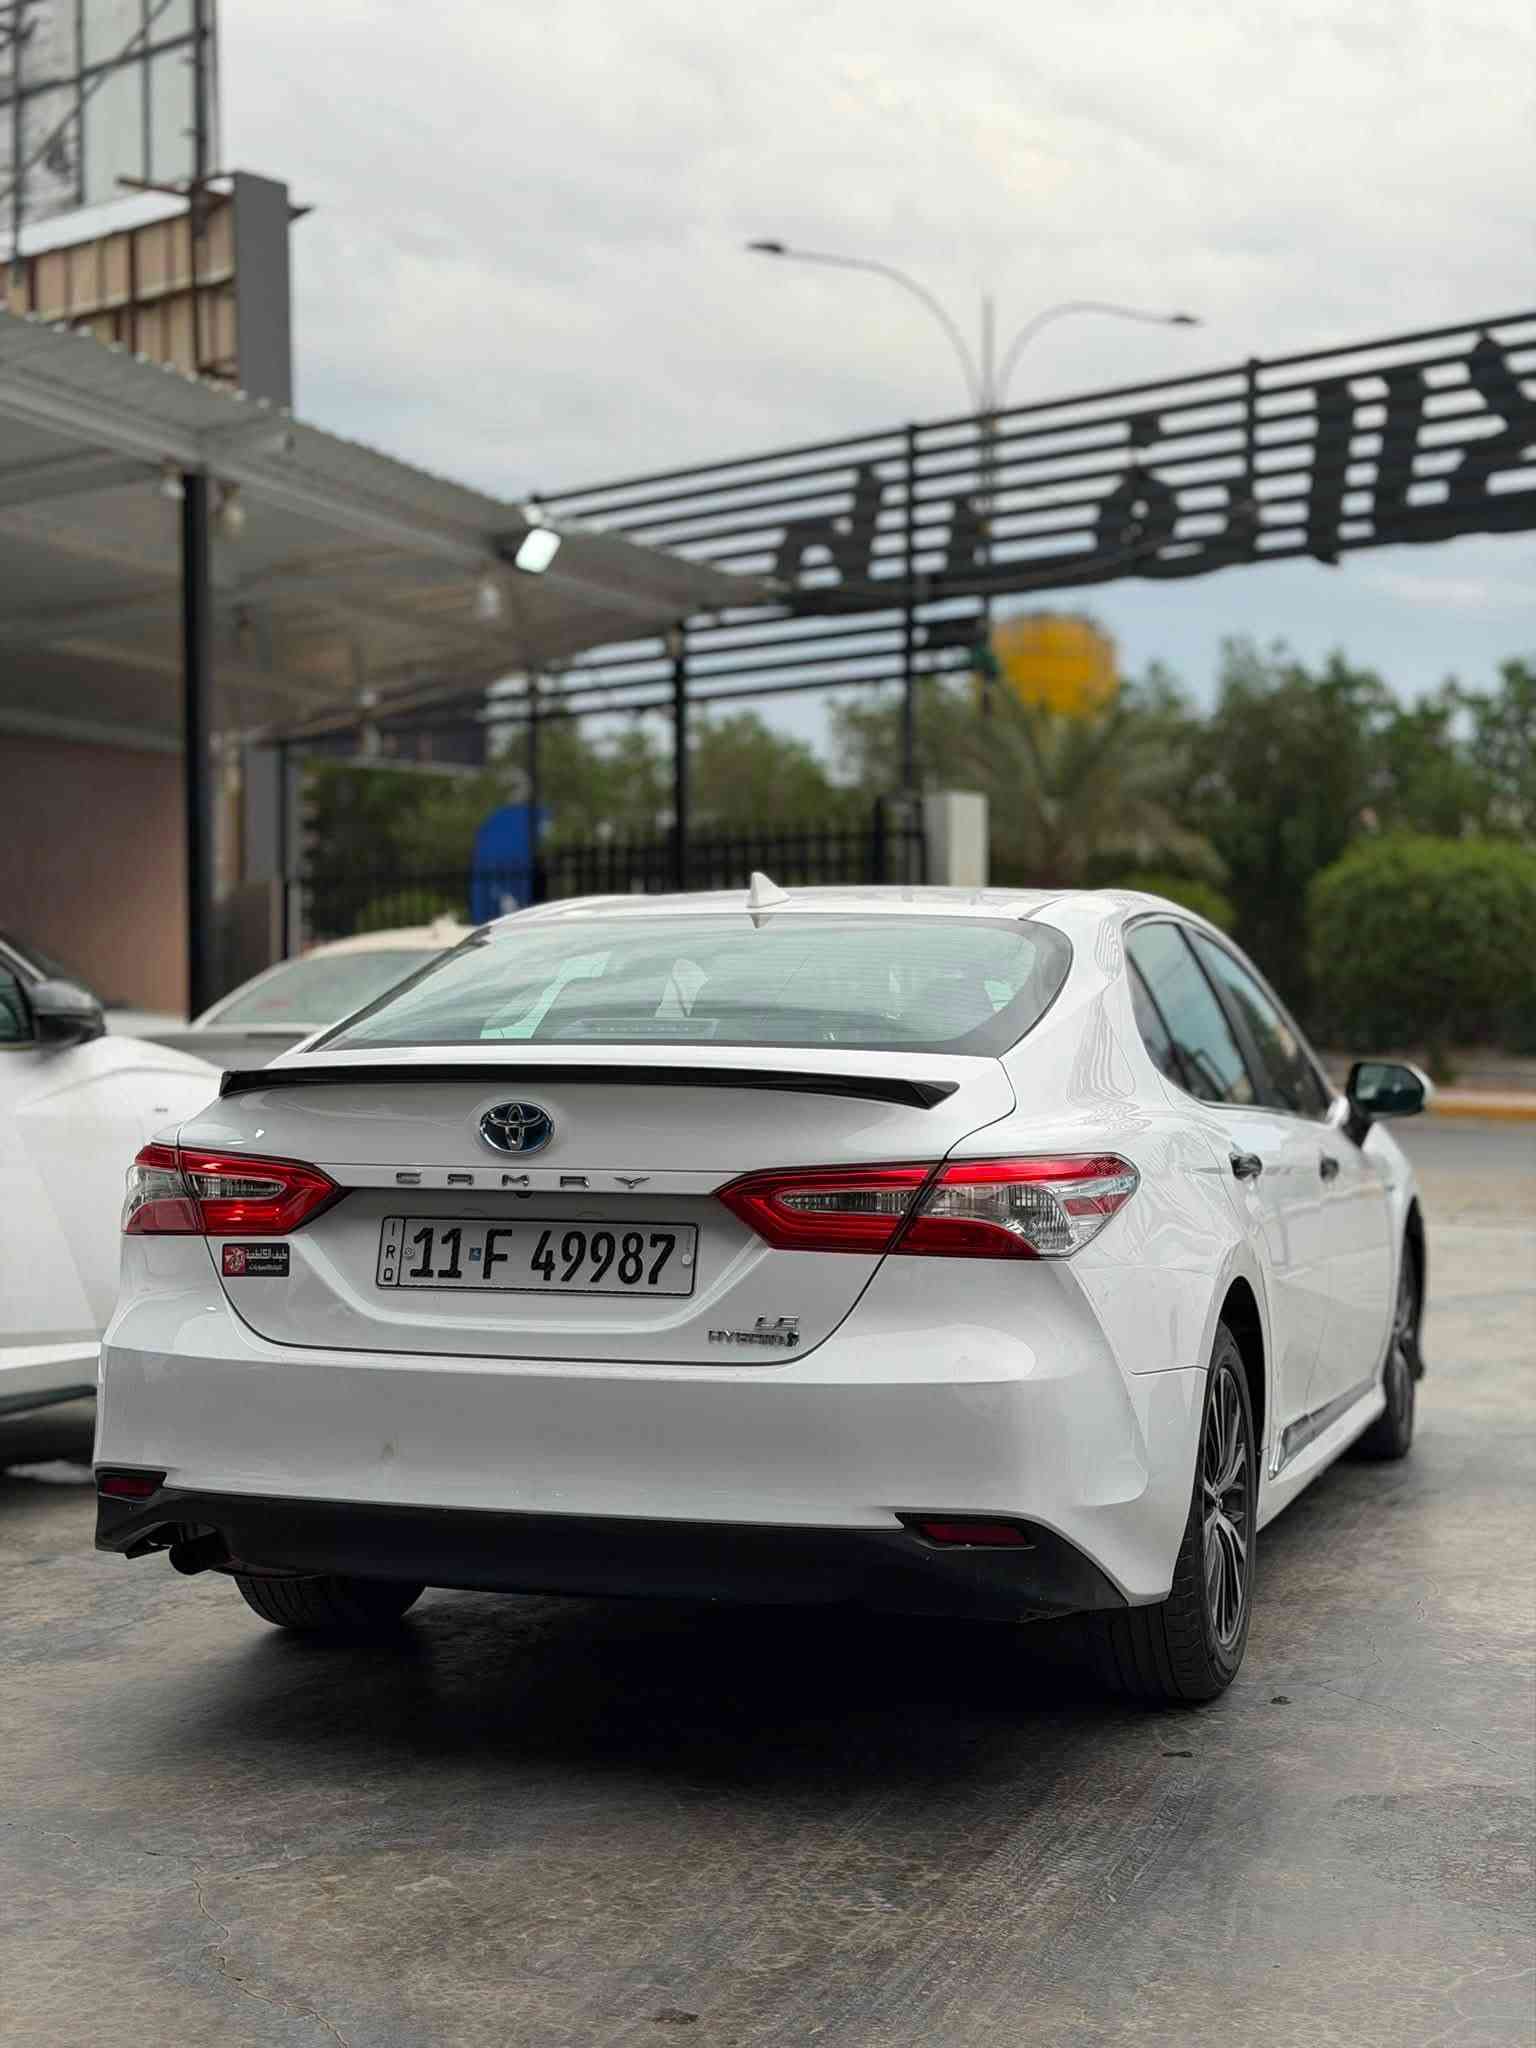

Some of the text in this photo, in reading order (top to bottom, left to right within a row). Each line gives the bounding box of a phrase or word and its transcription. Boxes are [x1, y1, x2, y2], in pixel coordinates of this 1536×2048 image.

[395, 1172, 651, 1189] CAMRY
[383, 1222, 396, 1283] IRQ
[409, 1227, 677, 1286] 11 F 49987
[755, 1314, 800, 1328] LE
